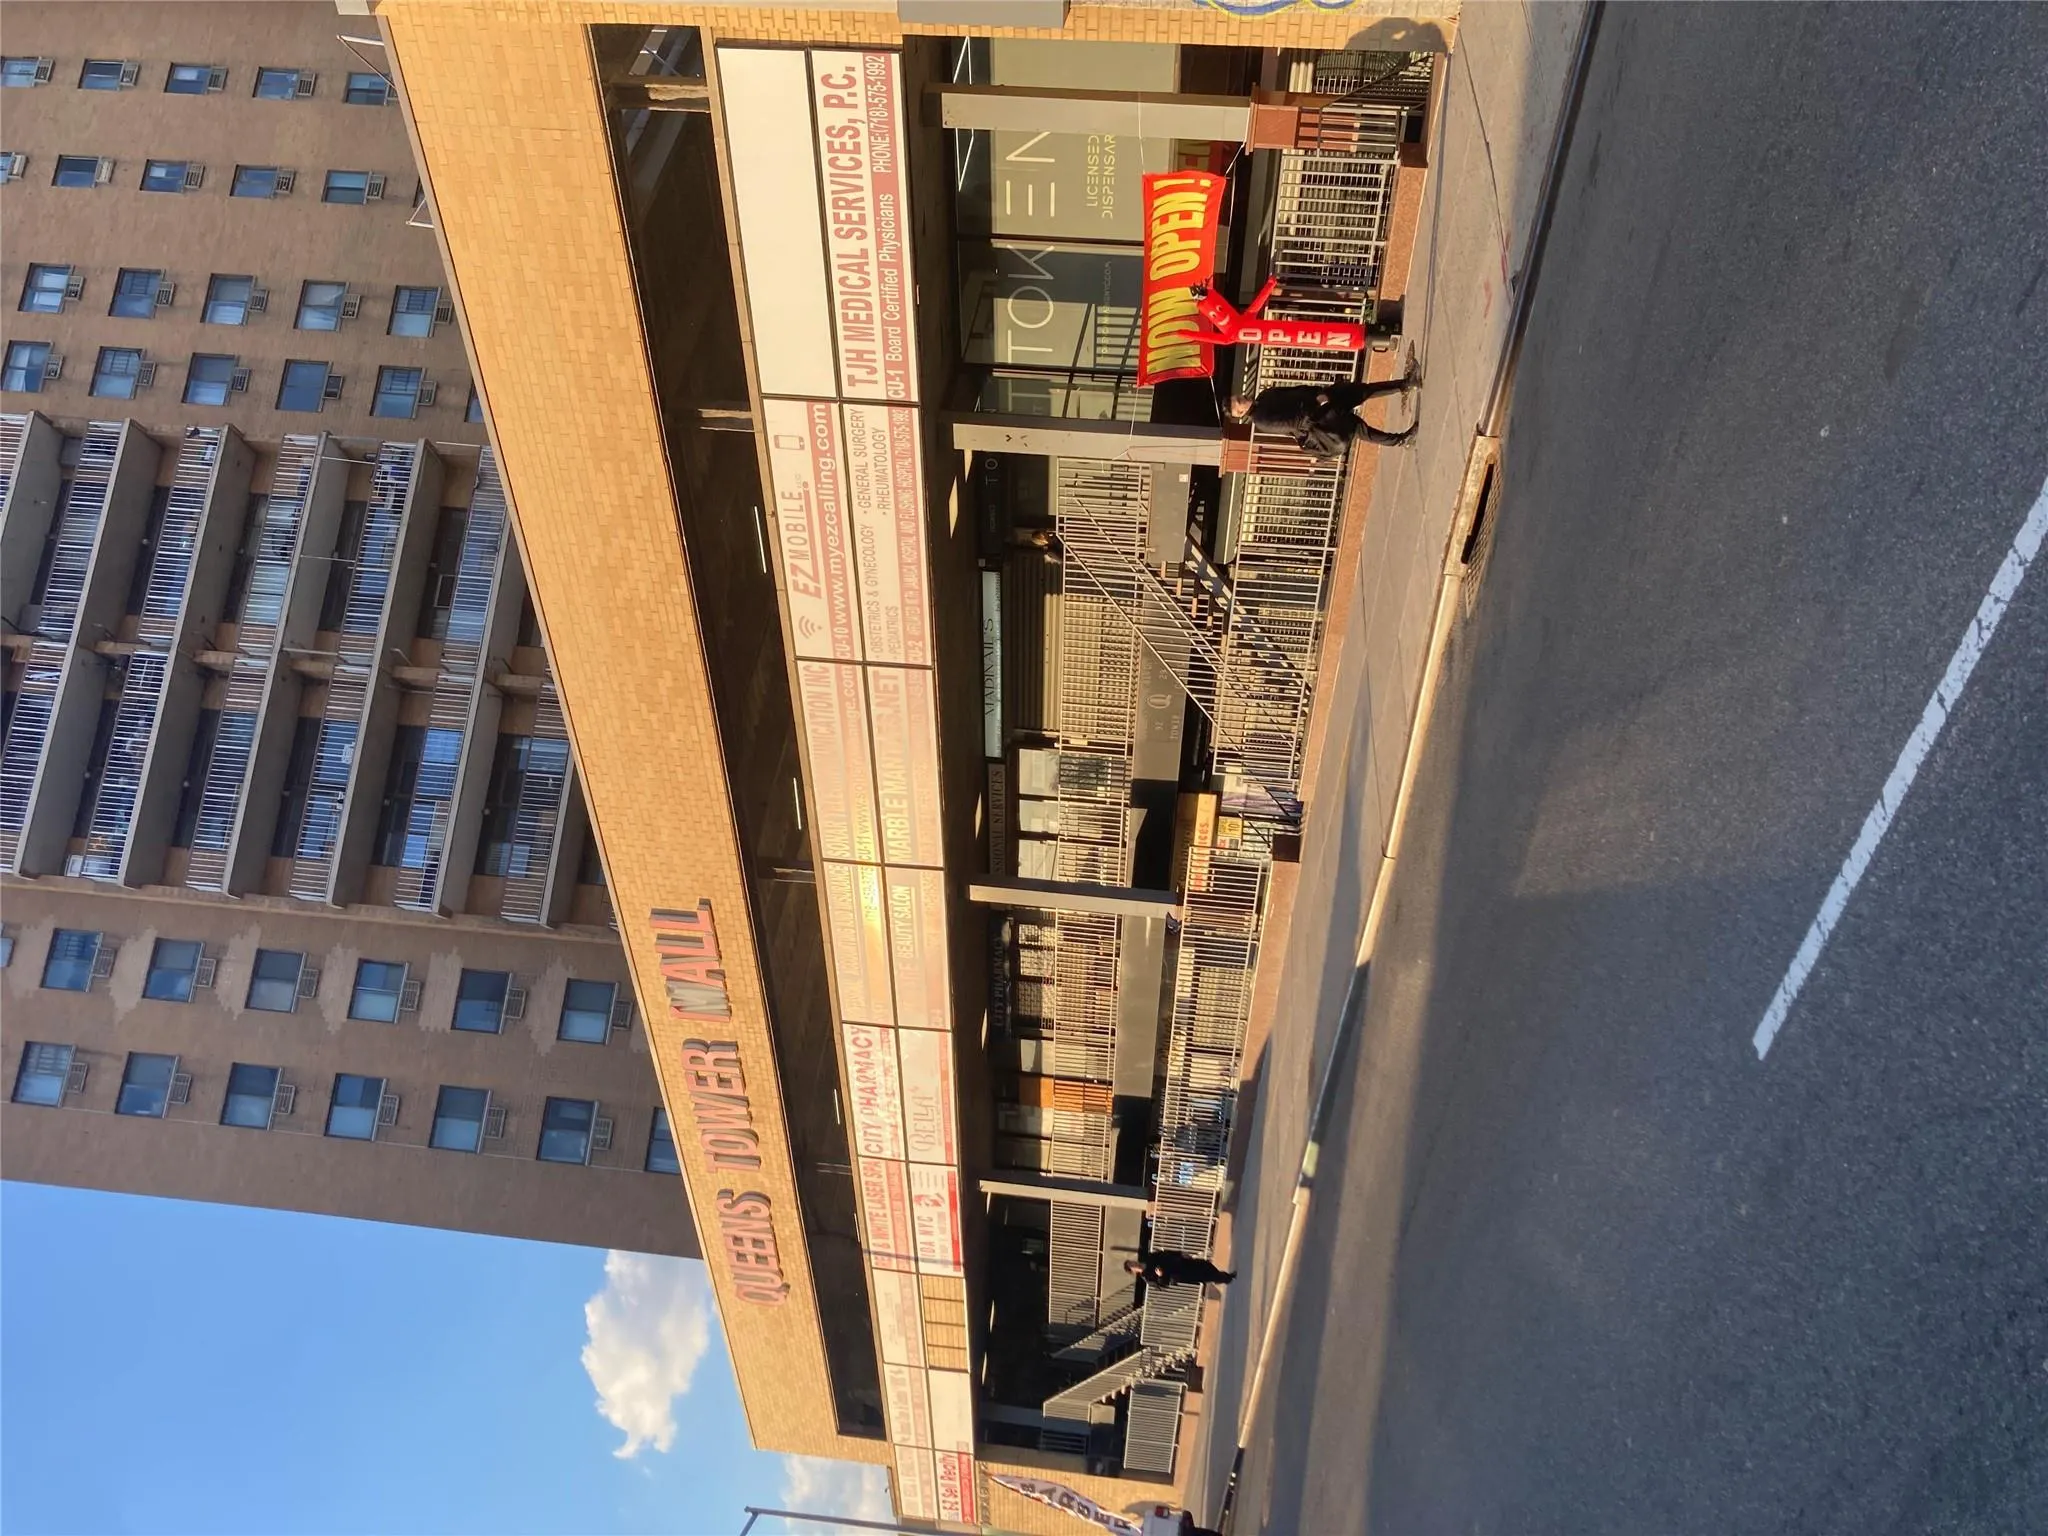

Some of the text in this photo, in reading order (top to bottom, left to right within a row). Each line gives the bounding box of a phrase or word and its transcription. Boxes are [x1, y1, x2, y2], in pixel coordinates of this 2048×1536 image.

[1086, 134, 1100, 207] LICENSED
[1101, 133, 1117, 219] DISPENSAR
[820, 65, 879, 388] TJH MEDICAL SERVICES, P.C.
[876, 193, 900, 262] Physicians
[876, 267, 901, 321] Certified
[880, 326, 903, 362] Board
[1146, 287, 1202, 375] NOW
[1237, 326, 1354, 349] OPEN
[887, 369, 906, 399] CU-1
[849, 408, 872, 509] GENERAL SURGERY
[872, 427, 891, 510] RHEUMATOLOGY
[781, 490, 822, 599] EZ MOBILE
[811, 404, 850, 659] CU-10 www.myezcalling.com
[860, 523, 879, 587] GYNECOLOGY
[865, 600, 884, 654] OBSTETRICS
[885, 606, 902, 655] PEDIATRICS
[907, 640, 924, 663] CU-2
[802, 664, 831, 687] INC
[990, 769, 1003, 824] SERVICES
[884, 798, 912, 860] MARBLE
[890, 884, 914, 919] SALON
[892, 920, 915, 959] BEAUTY
[850, 1025, 879, 1116] PHARMACY
[649, 898, 790, 1306] QUEENS TOWER MALL
[861, 1122, 884, 1154] CITY
[861, 1160, 883, 1179] SPA
[864, 1181, 887, 1210] LASER
